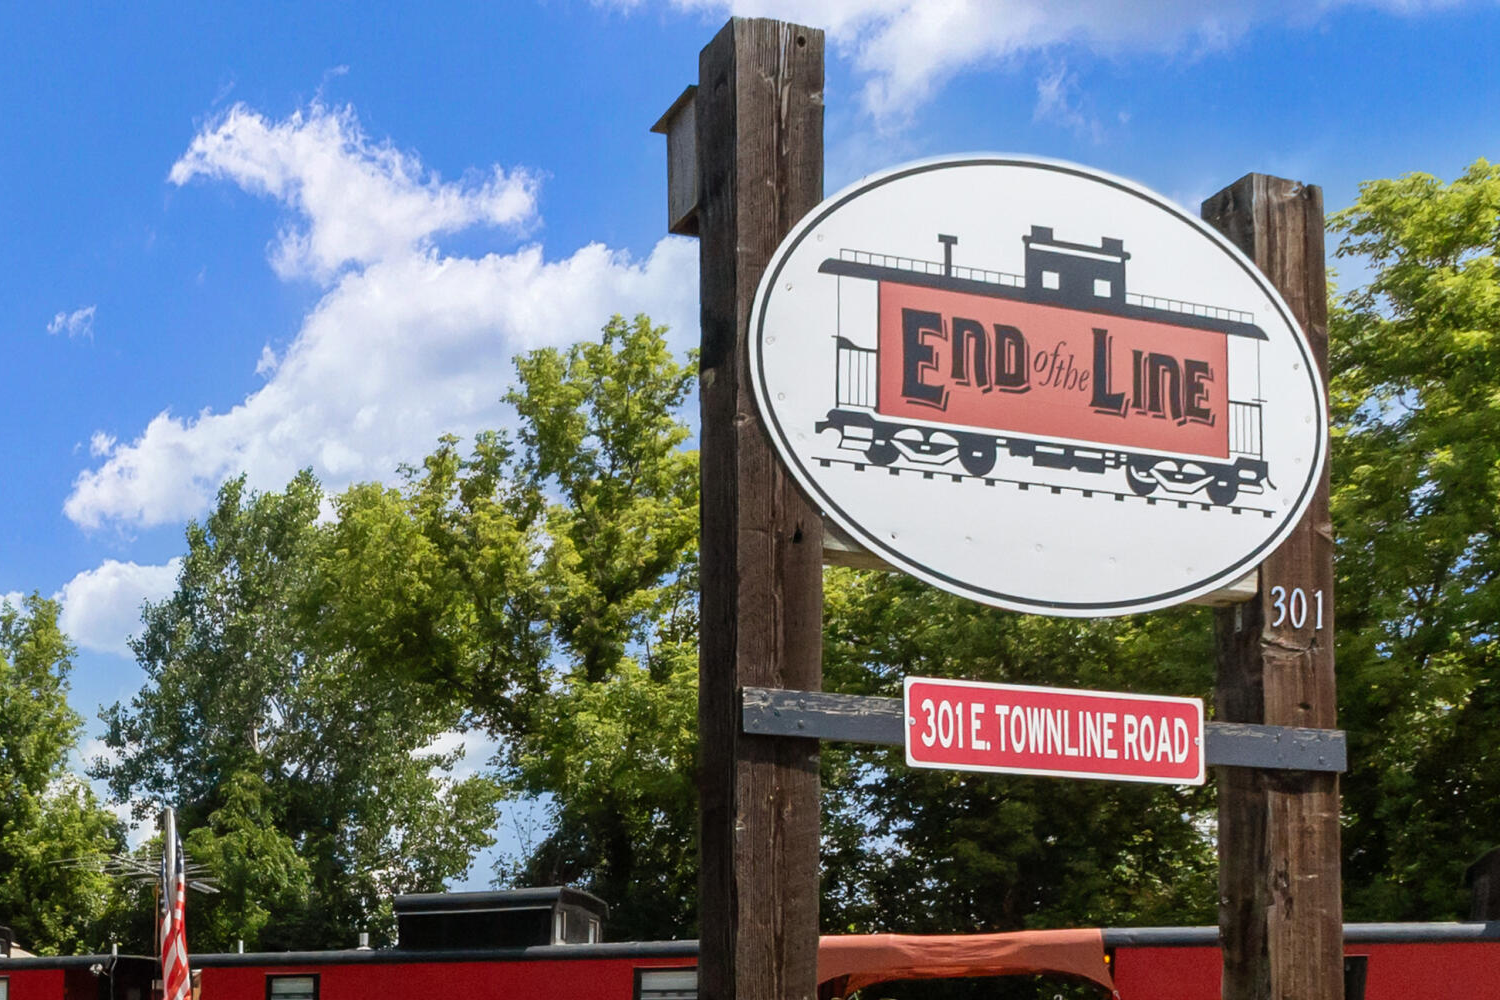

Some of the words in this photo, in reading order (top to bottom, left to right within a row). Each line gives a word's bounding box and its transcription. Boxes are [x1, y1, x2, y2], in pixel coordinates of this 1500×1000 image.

[1034, 341, 1063, 387] of
[1053, 350, 1090, 394] the
[1271, 585, 1323, 631] 301
[921, 698, 964, 749] 301
[971, 702, 991, 751] E.
[995, 704, 1119, 760] TOWNLINE
[1123, 714, 1190, 764] ROAD
